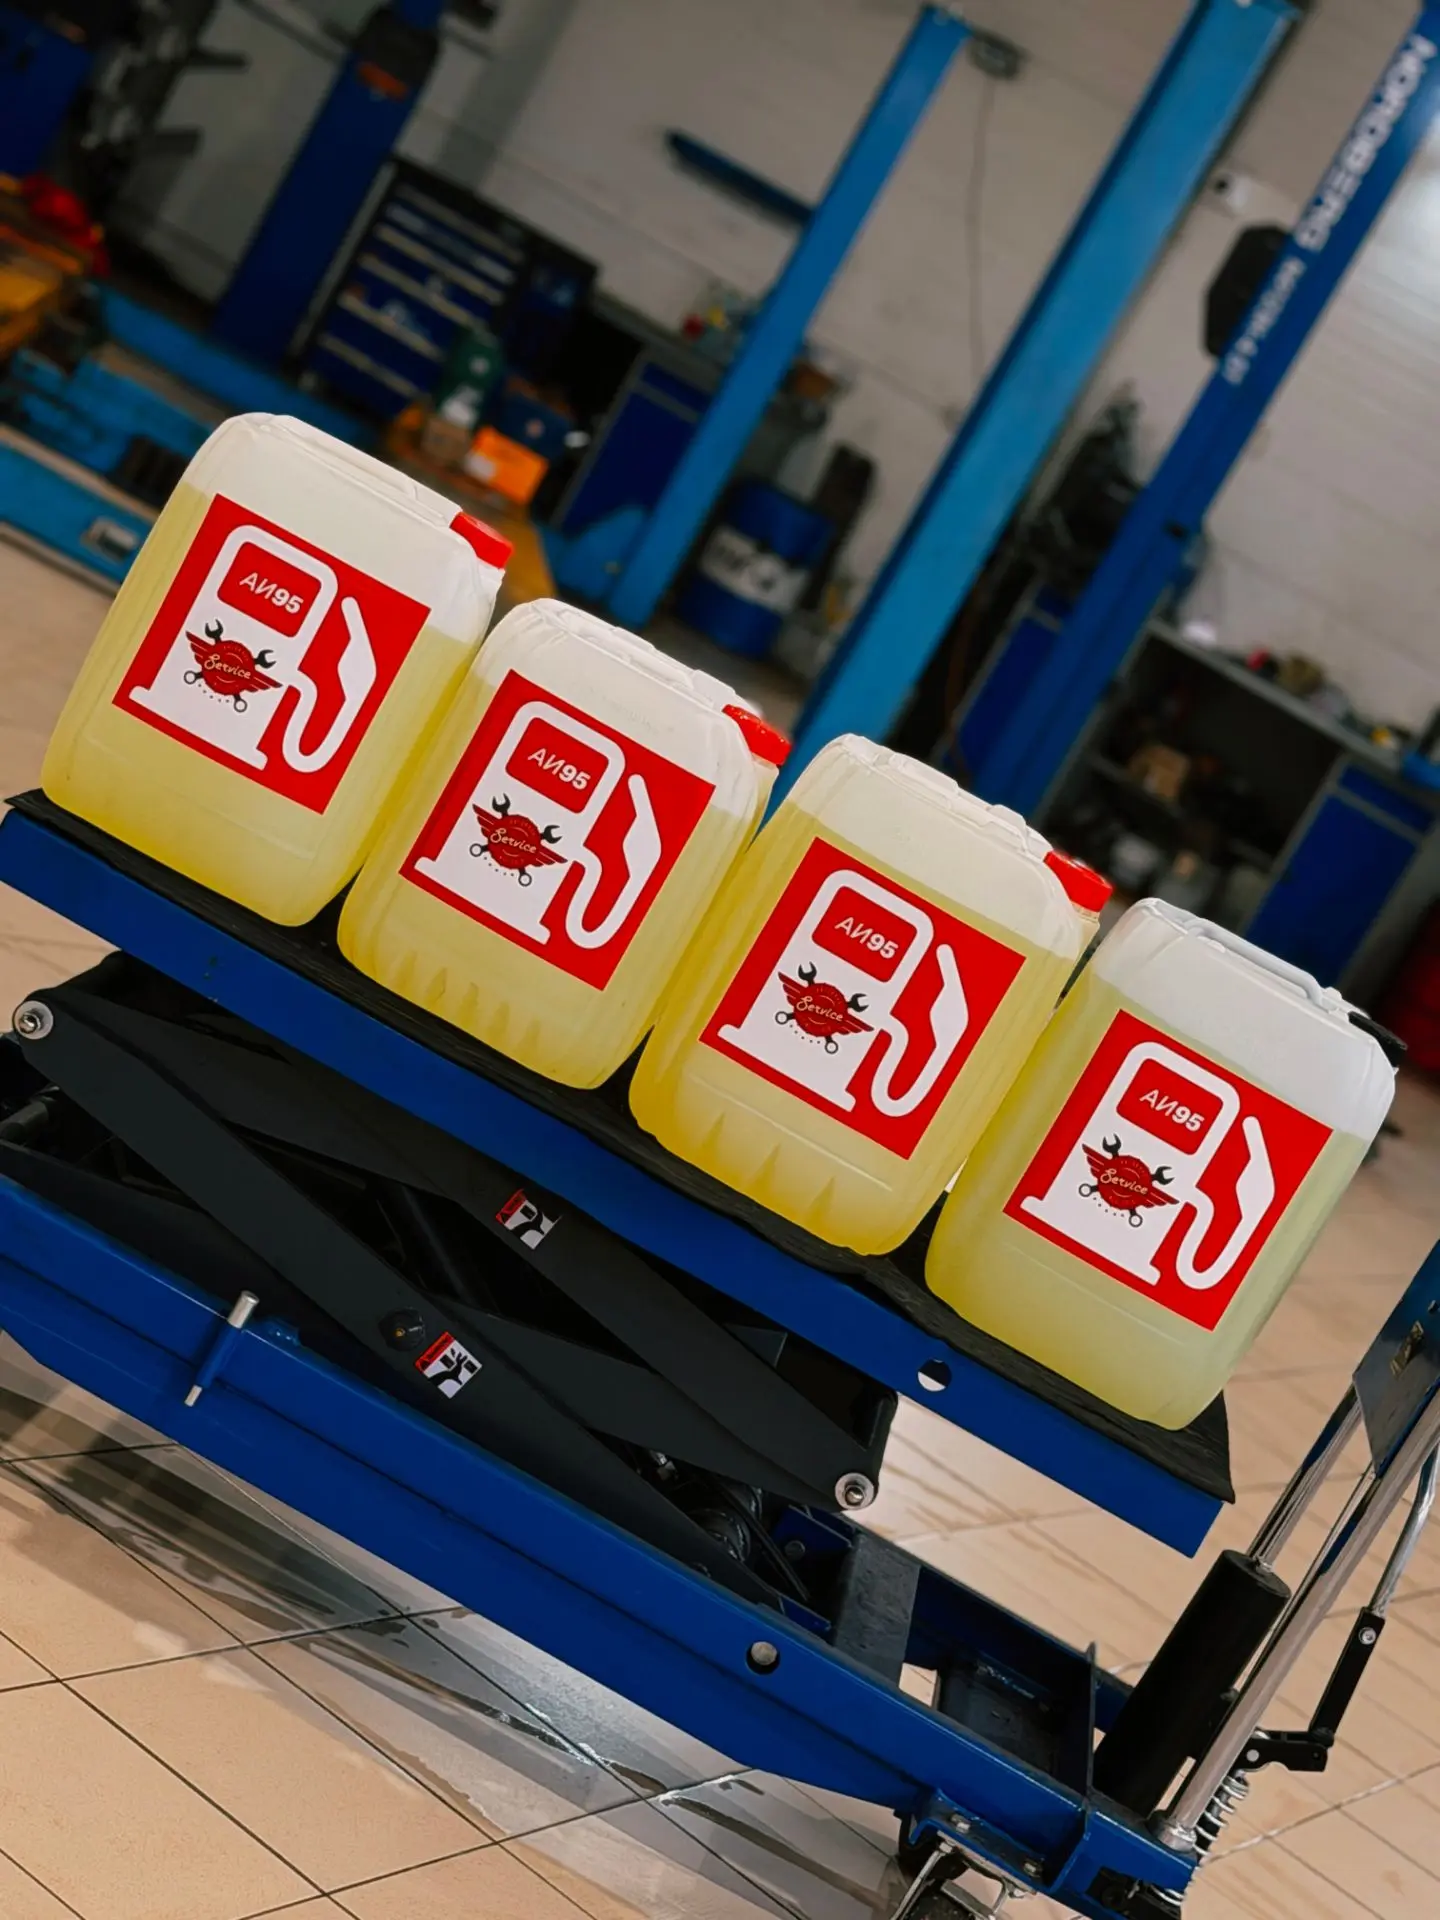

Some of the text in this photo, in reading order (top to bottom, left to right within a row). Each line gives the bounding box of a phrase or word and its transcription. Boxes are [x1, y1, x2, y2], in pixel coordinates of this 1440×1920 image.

[1294, 33, 1437, 250] NORDBERG
[239, 572, 305, 614] АИ95
[203, 653, 252, 680] Service
[527, 747, 592, 790] АИ95
[489, 827, 538, 854] Service
[834, 916, 899, 959] АИ95
[795, 995, 845, 1022] Service
[1139, 1089, 1205, 1132] АИ95
[1099, 1167, 1149, 1195] Service
